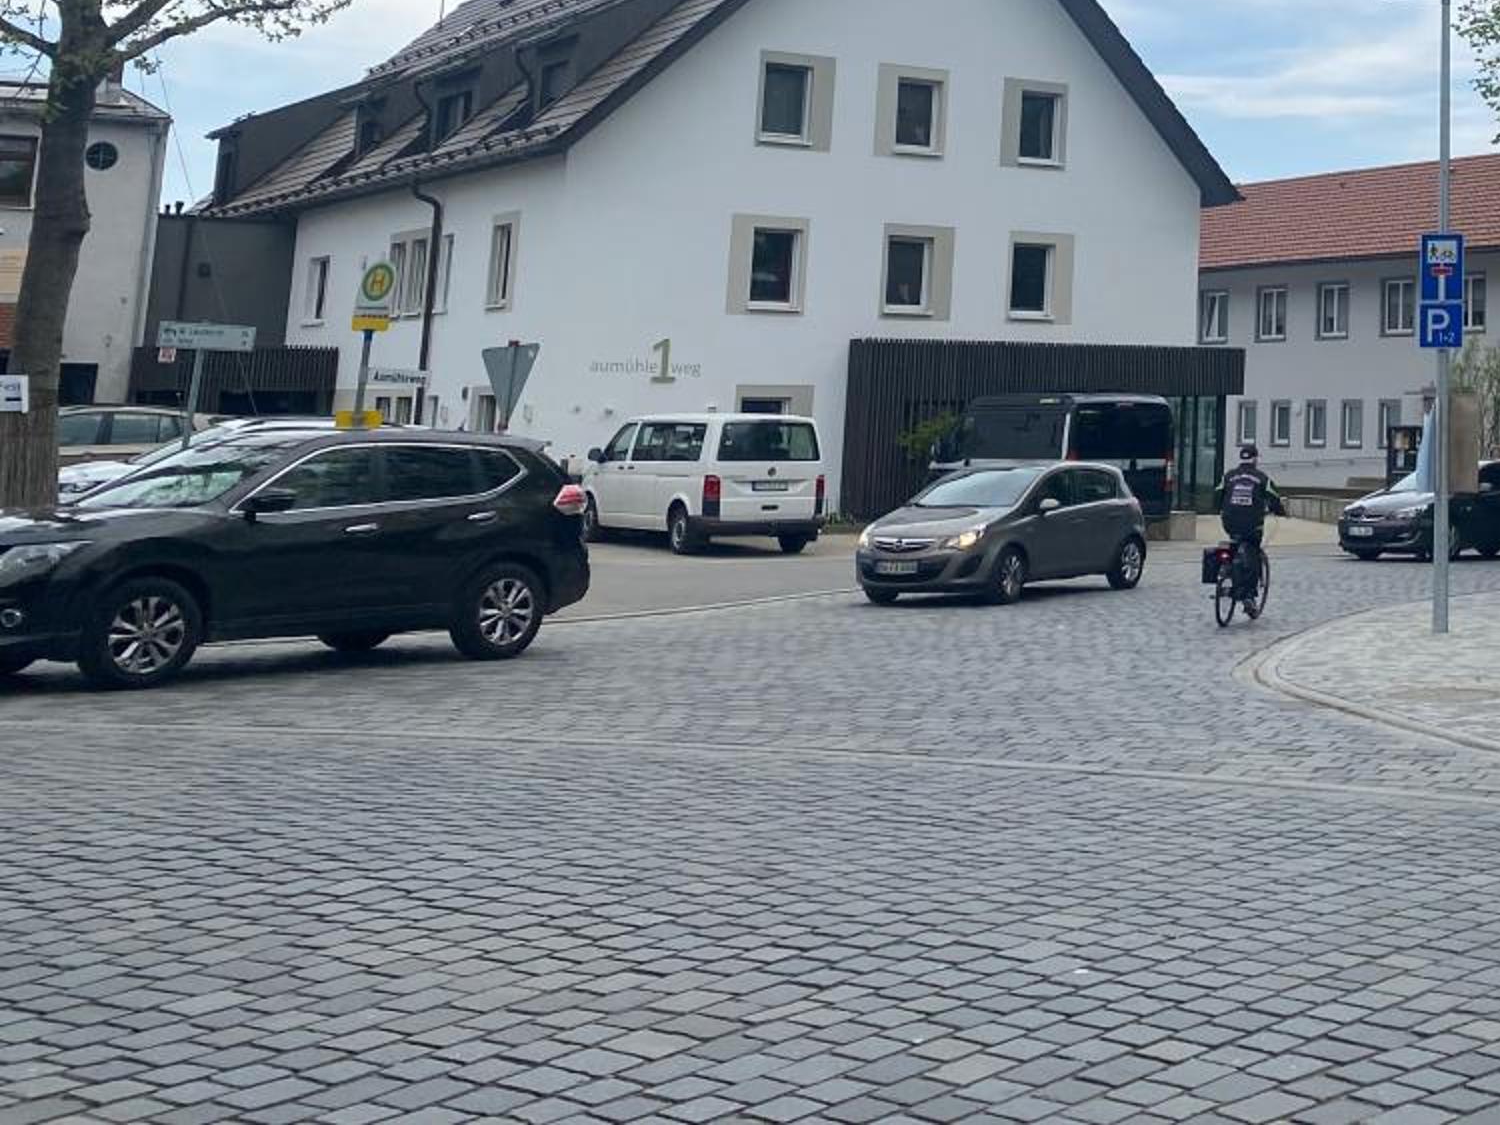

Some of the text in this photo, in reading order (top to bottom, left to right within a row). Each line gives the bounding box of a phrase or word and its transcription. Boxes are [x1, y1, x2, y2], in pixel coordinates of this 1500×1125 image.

[1427, 308, 1450, 342] P
[651, 338, 676, 383] 1
[672, 363, 701, 377] weg
